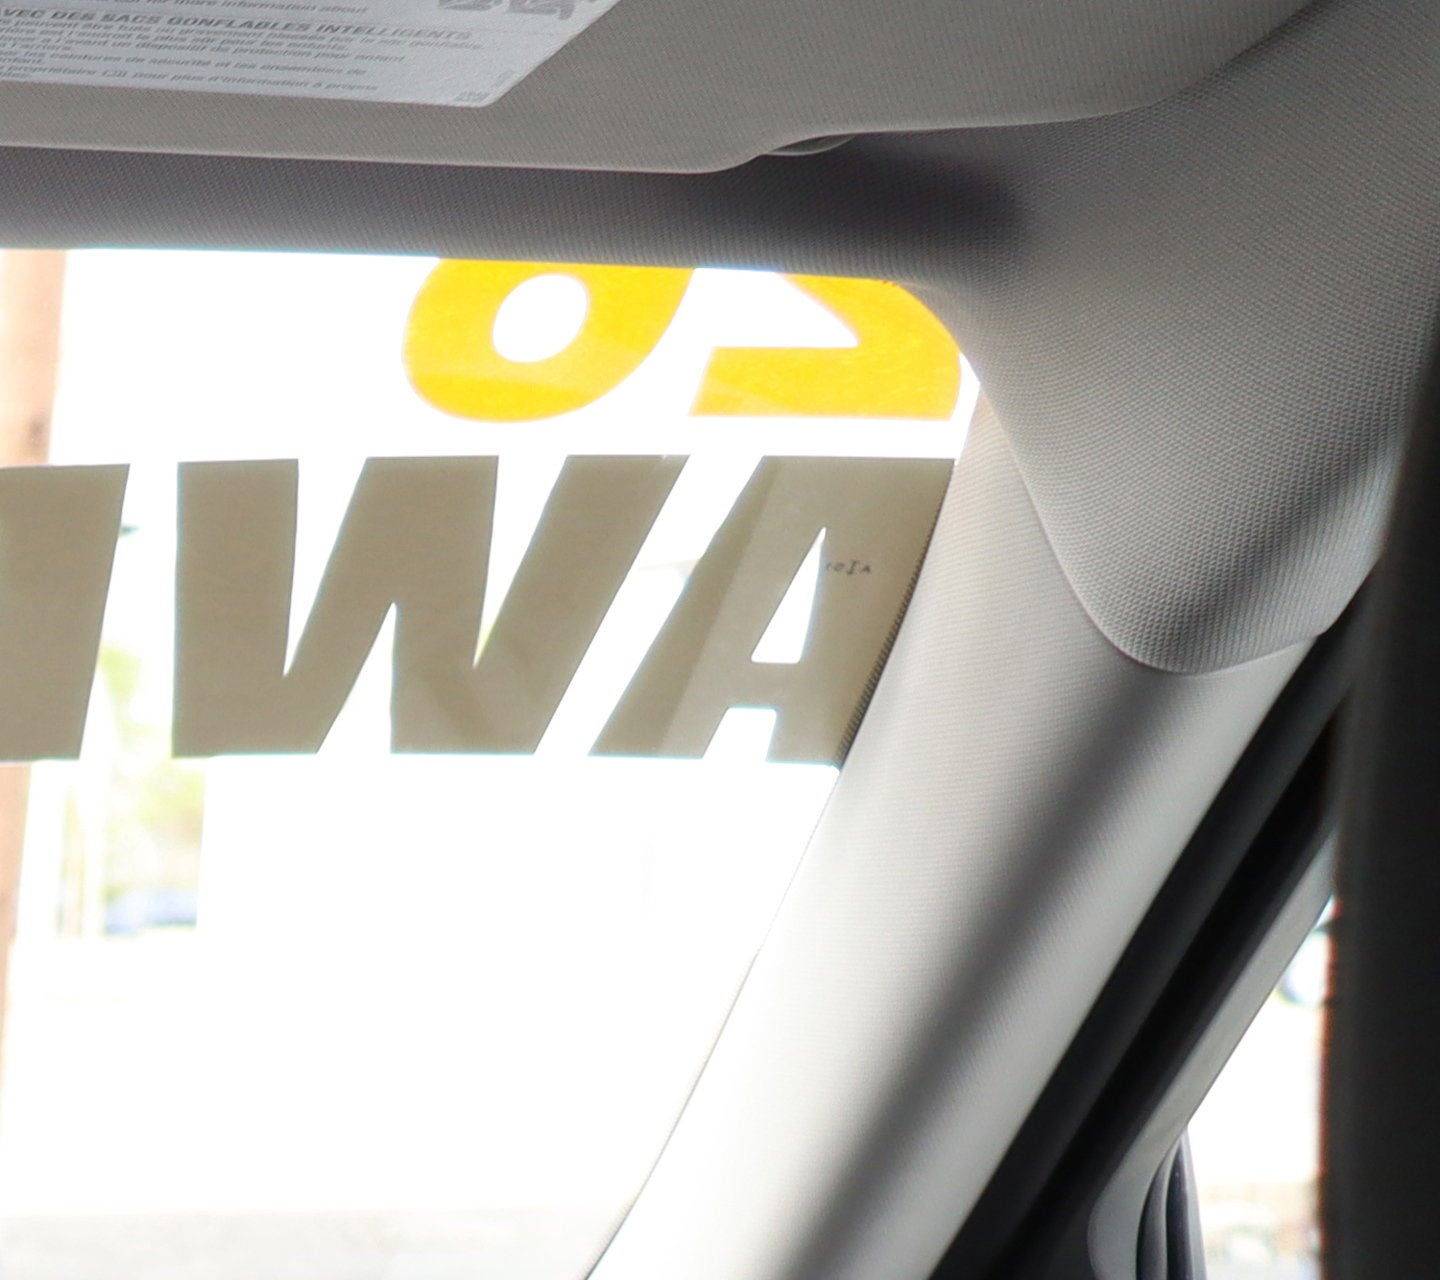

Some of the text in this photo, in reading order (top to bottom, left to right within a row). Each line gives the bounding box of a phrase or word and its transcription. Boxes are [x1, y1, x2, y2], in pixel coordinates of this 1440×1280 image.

[49, 9, 98, 21] DES
[99, 12, 162, 25] SACS
[164, 15, 312, 33] GONFLABLES
[314, 23, 473, 40] INTELLIGENTS
